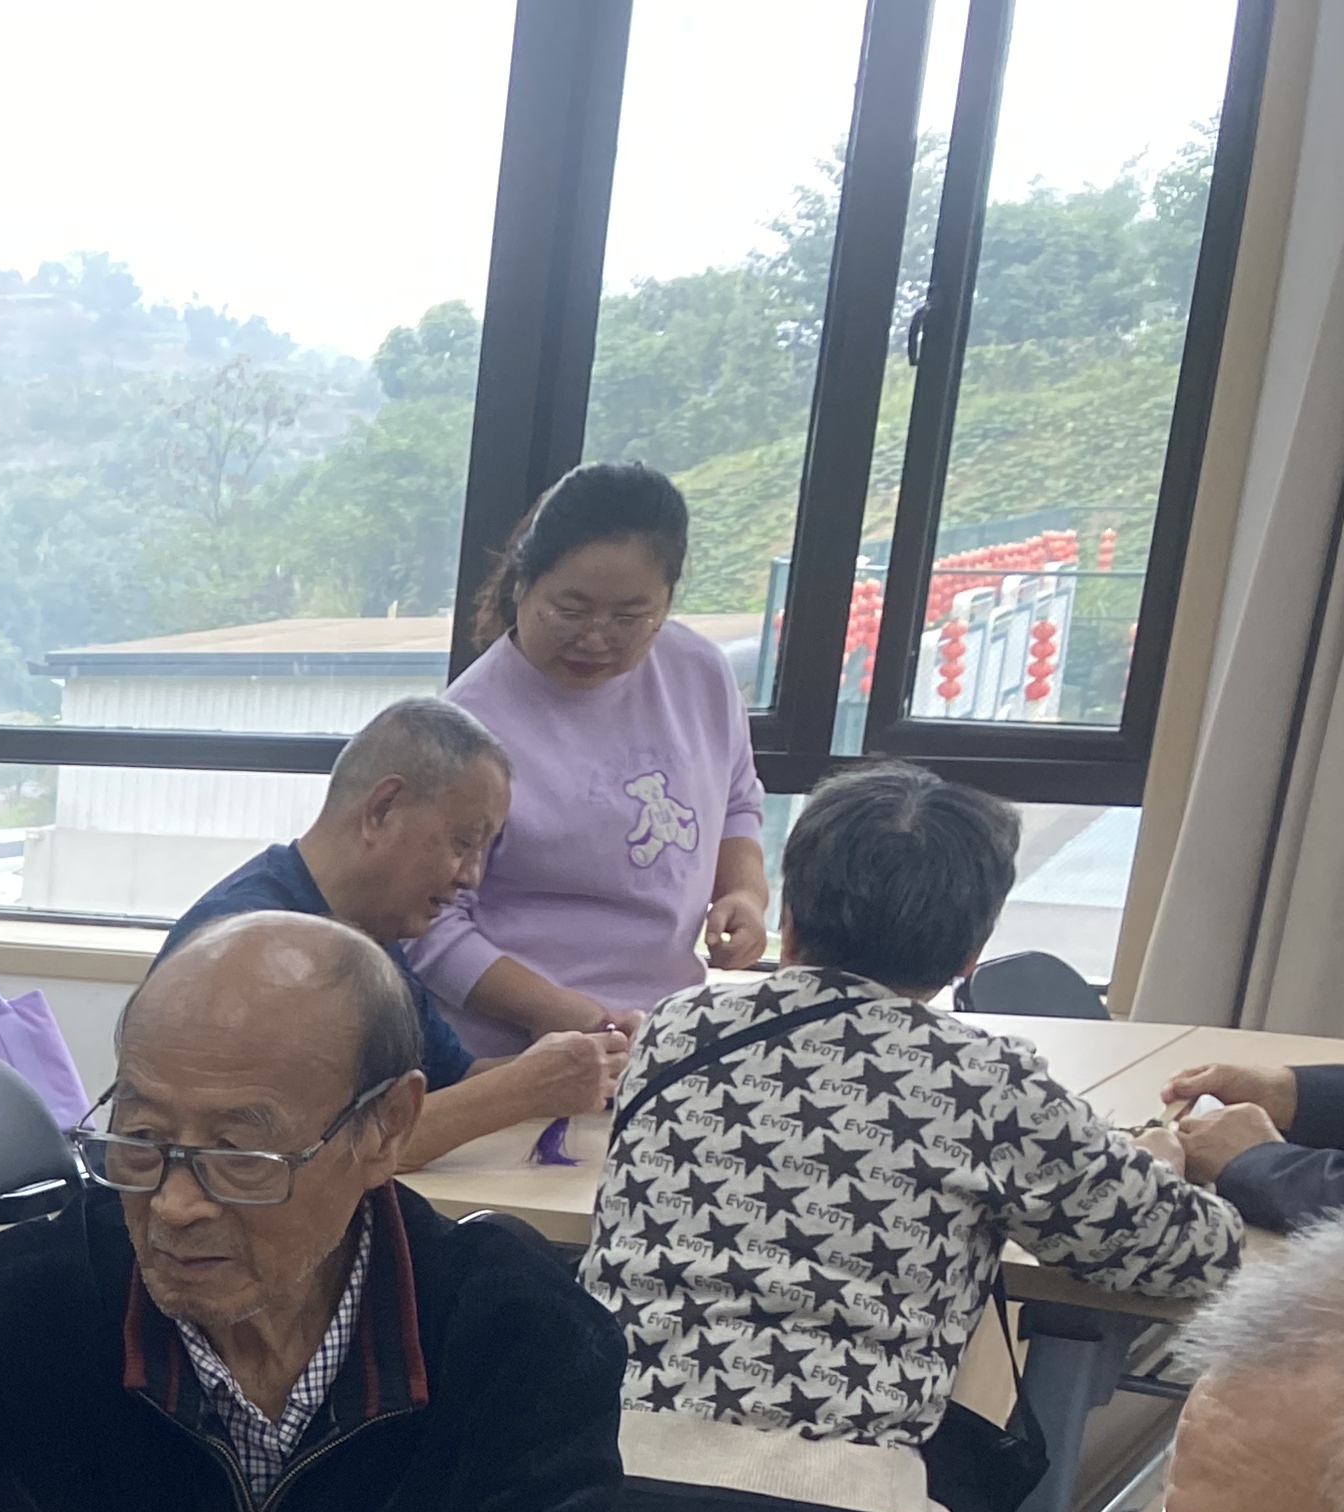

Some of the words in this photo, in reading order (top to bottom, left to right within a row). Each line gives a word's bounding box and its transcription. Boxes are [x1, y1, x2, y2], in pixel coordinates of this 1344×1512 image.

[868, 1005, 911, 1028] EVOT
[663, 1032, 695, 1053] EVOT
[802, 1039, 842, 1061] EVOT
[886, 1043, 930, 1068] EVOT
[968, 1057, 1009, 1084] EVOT
[681, 1076, 706, 1092] VOT
[742, 1075, 781, 1098] EVOT
[819, 1079, 865, 1102] EVOT
[910, 1085, 954, 1115] EVOT
[686, 1110, 723, 1133] EVOT
[760, 1114, 801, 1137] EVOT
[844, 1119, 891, 1146] EVOT
[640, 1150, 673, 1173] EVOT
[705, 1151, 744, 1175] EVOT
[932, 1135, 971, 1167] EVOT
[781, 1156, 826, 1182] EVOT
[869, 1166, 914, 1196] EVOT
[656, 1191, 691, 1215] EVOT
[726, 1193, 765, 1219] EVOT
[806, 1202, 853, 1230] EVOT
[892, 1216, 928, 1243] EVOT
[677, 1234, 712, 1257] EVOT
[747, 1239, 788, 1264] EVOT
[630, 1274, 662, 1296] EVOT
[695, 1275, 732, 1297] EVOT
[768, 1281, 812, 1308] EVOT
[853, 1293, 888, 1326] EVOT
[648, 1312, 680, 1334] EVOT
[716, 1316, 754, 1335] EVOT
[668, 1355, 696, 1377] EVOT
[732, 1357, 773, 1383] EVOT
[812, 1366, 849, 1393] EVOT
[876, 1381, 907, 1407] EVOT
